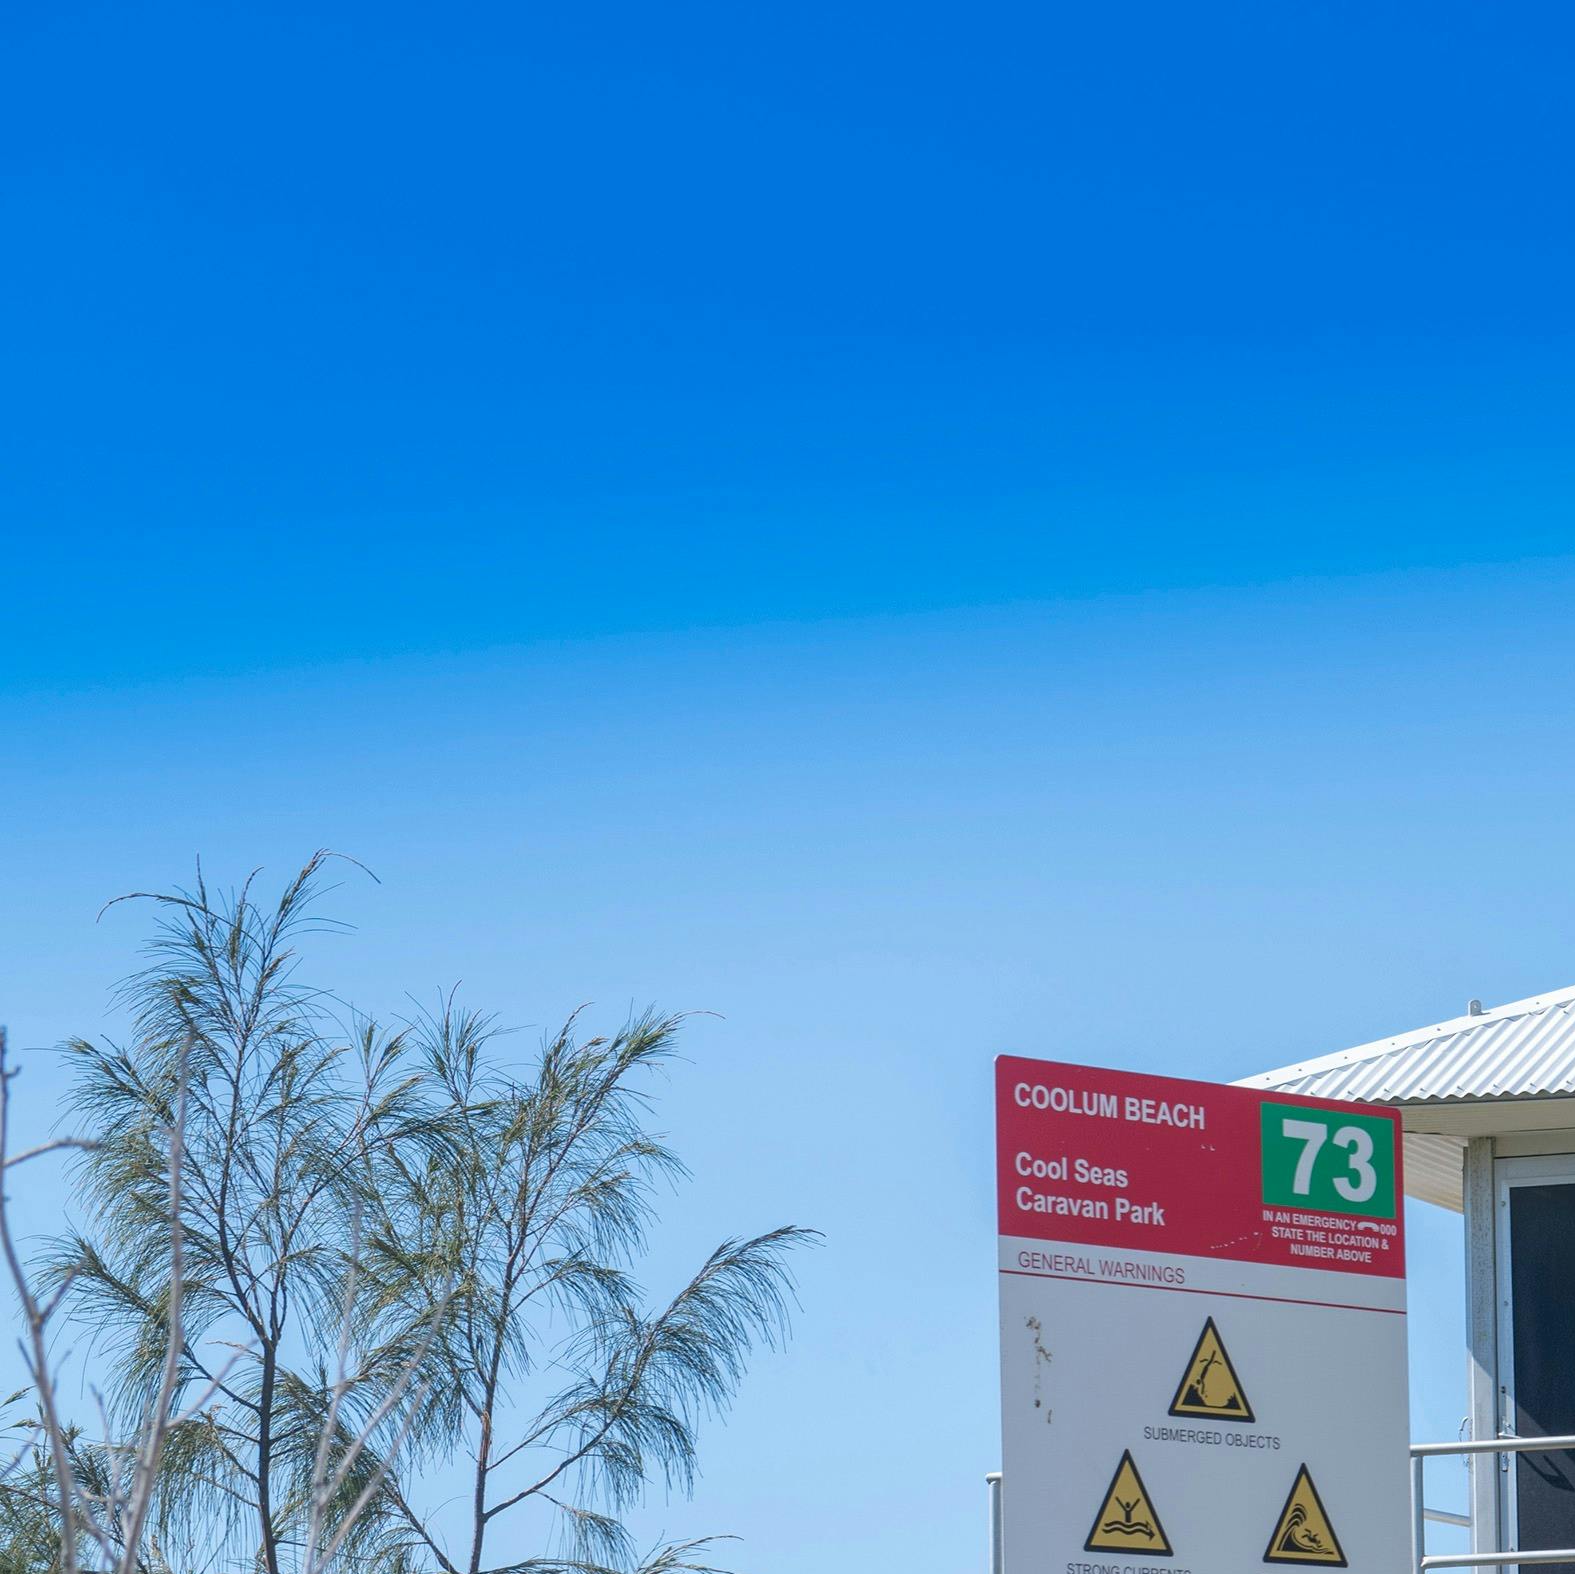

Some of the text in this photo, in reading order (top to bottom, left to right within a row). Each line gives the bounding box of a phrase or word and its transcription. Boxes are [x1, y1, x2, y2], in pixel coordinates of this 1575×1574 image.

[1014, 1082, 1205, 1130] COOLUM BEACH
[1015, 1152, 1129, 1188] Cool Seas
[1282, 1118, 1377, 1202] 73
[1016, 1186, 1165, 1226] Caravan Park
[1263, 1210, 1397, 1236] IN AN EMERGENCY 000
[1272, 1226, 1389, 1250] STATE THE LOCATION &
[1018, 1251, 1185, 1284] GENERAL WARNINGS
[1290, 1243, 1372, 1263] NUMBER ABOVE
[1144, 1426, 1281, 1450] SUBMERGED OBJECTS
